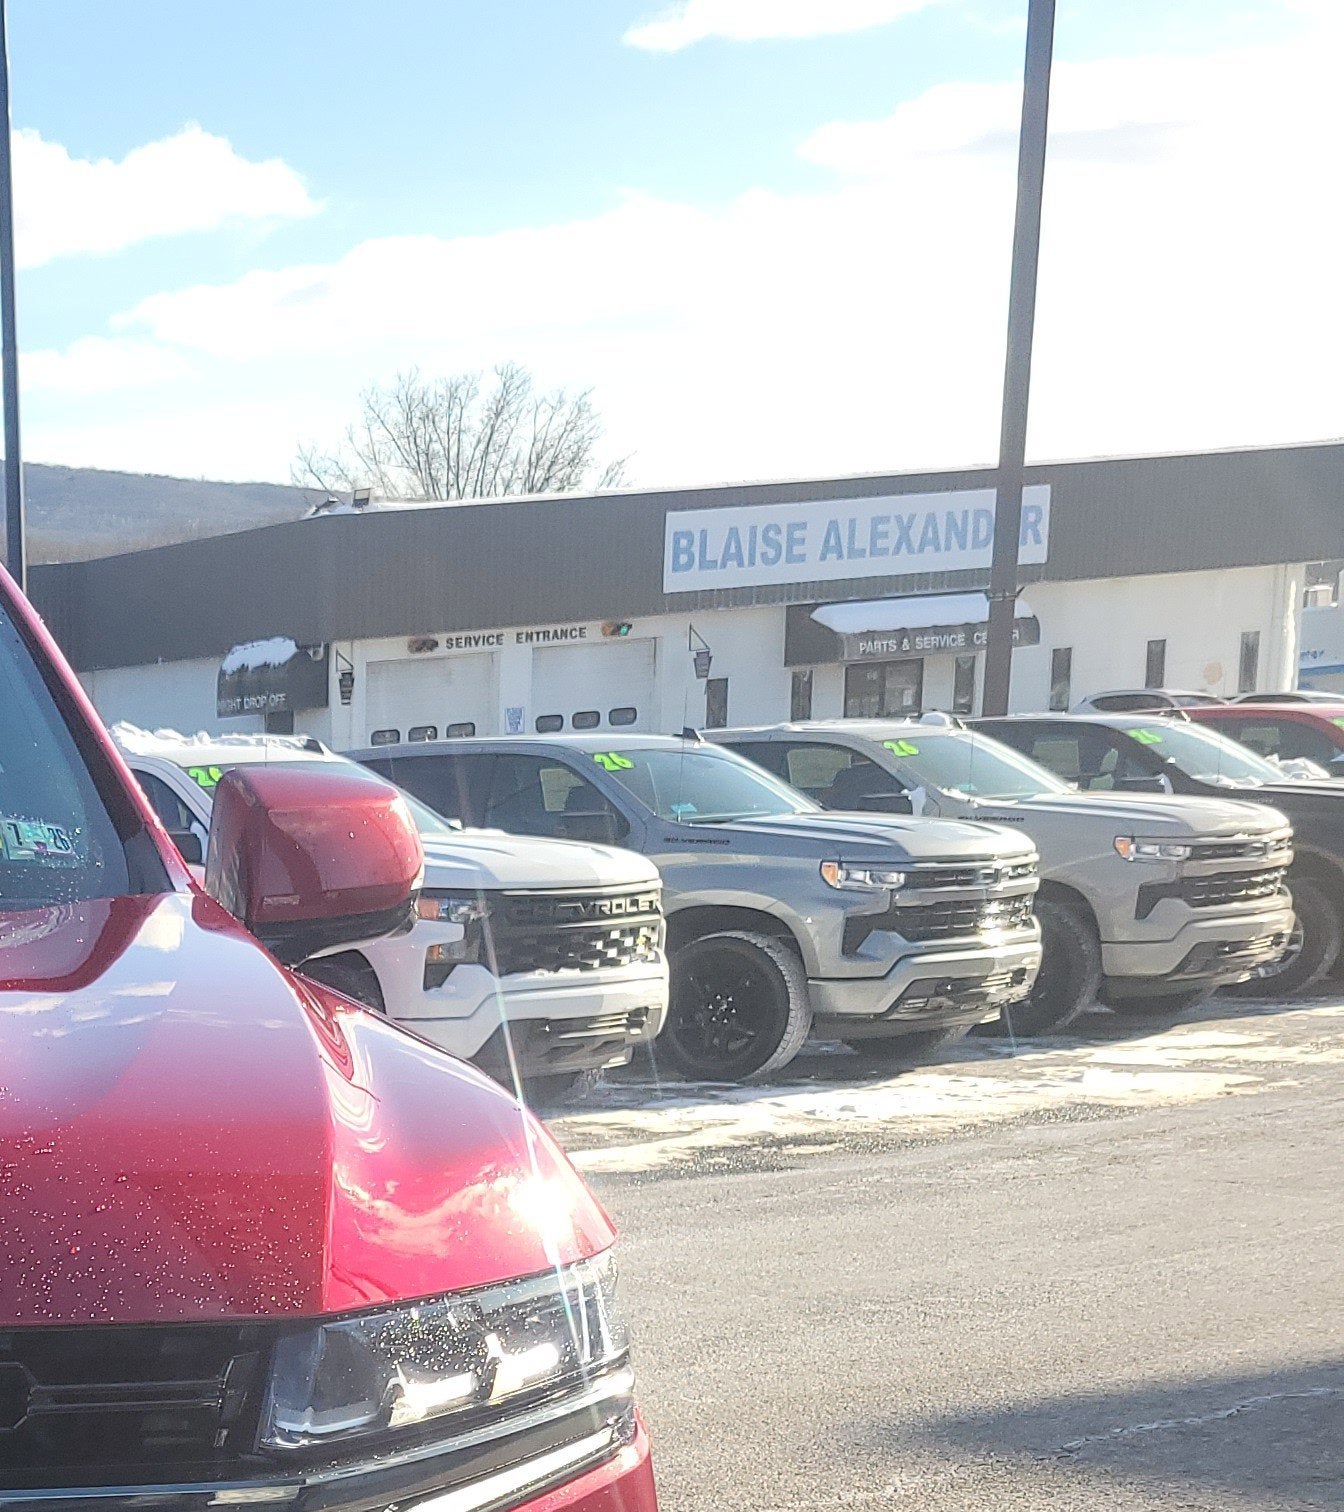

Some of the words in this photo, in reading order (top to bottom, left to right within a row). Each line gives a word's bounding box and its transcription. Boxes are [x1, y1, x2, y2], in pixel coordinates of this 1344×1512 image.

[671, 522, 808, 574] BLAISE
[819, 504, 1043, 560] ALEXANDR
[446, 633, 504, 650] SERVICE
[516, 627, 587, 645] ENTRANCE
[860, 639, 897, 654] PARTS
[901, 639, 910, 651] &
[915, 633, 965, 649] SERVICE
[883, 740, 919, 757] 26
[593, 752, 634, 771] 26
[48, 827, 71, 851] 26
